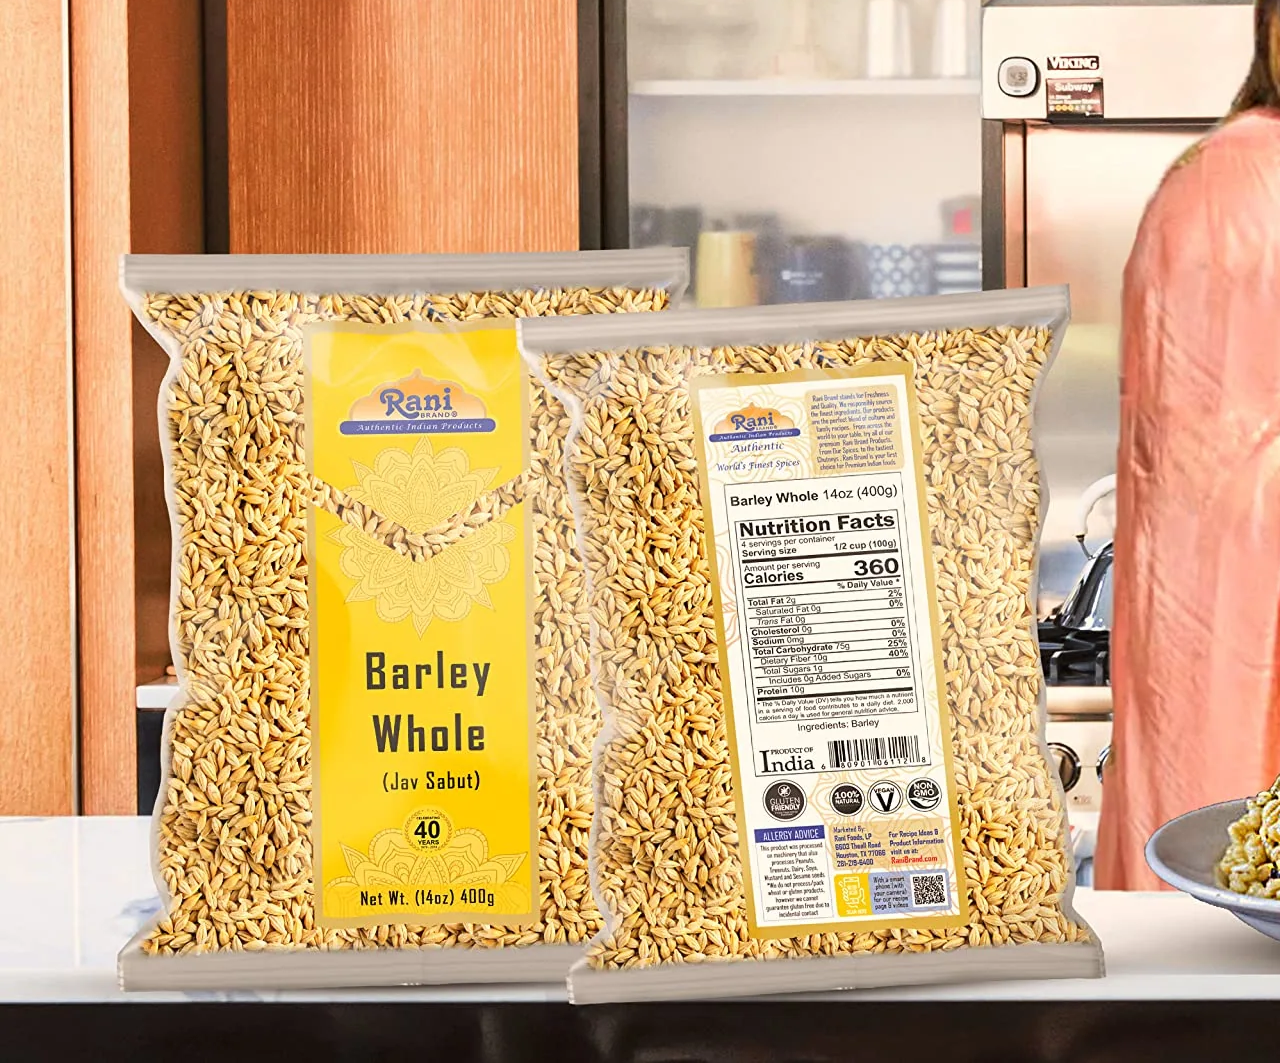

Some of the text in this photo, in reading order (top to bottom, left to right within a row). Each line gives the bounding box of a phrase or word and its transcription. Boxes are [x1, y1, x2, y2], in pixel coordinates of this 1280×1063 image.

[1048, 58, 1097, 68] VIKING
[1055, 83, 1094, 92] Subway
[380, 387, 452, 419] Rani
[357, 422, 403, 431] Authentic
[731, 412, 774, 431] Rani
[731, 442, 784, 453] Authentic
[716, 459, 800, 471] World's Finest Spices
[730, 484, 897, 506] Barley Whole 14oz (400g)
[740, 513, 894, 537] Nutrition Facts
[742, 548, 776, 557] Serving
[779, 546, 796, 554] size
[834, 542, 847, 550] 1/2
[869, 539, 897, 549] (100g)
[749, 539, 781, 548] servings
[799, 535, 835, 544] container
[744, 560, 820, 572] Amount per serving
[744, 558, 899, 584] Calories 360
[848, 581, 867, 589] Daily
[756, 607, 793, 616] Saturated
[752, 627, 799, 636] Cholesterol
[802, 626, 812, 634] 0g
[776, 644, 833, 654] Carbohydrate
[761, 657, 788, 665] Dietary
[366, 651, 490, 696] Barley
[769, 676, 802, 684] Includes
[816, 673, 841, 681] Added
[844, 671, 871, 680] Sugars
[798, 719, 879, 732] Ingredients: Barley
[372, 713, 484, 752] Whole
[759, 750, 815, 773] India
[383, 770, 480, 792] (Jav Sabut)
[835, 790, 859, 798] 100%
[414, 820, 440, 838] 40
[764, 829, 818, 841] ALLERGY ADVICE
[360, 889, 494, 906] Net Wt. (14oz) 400g
